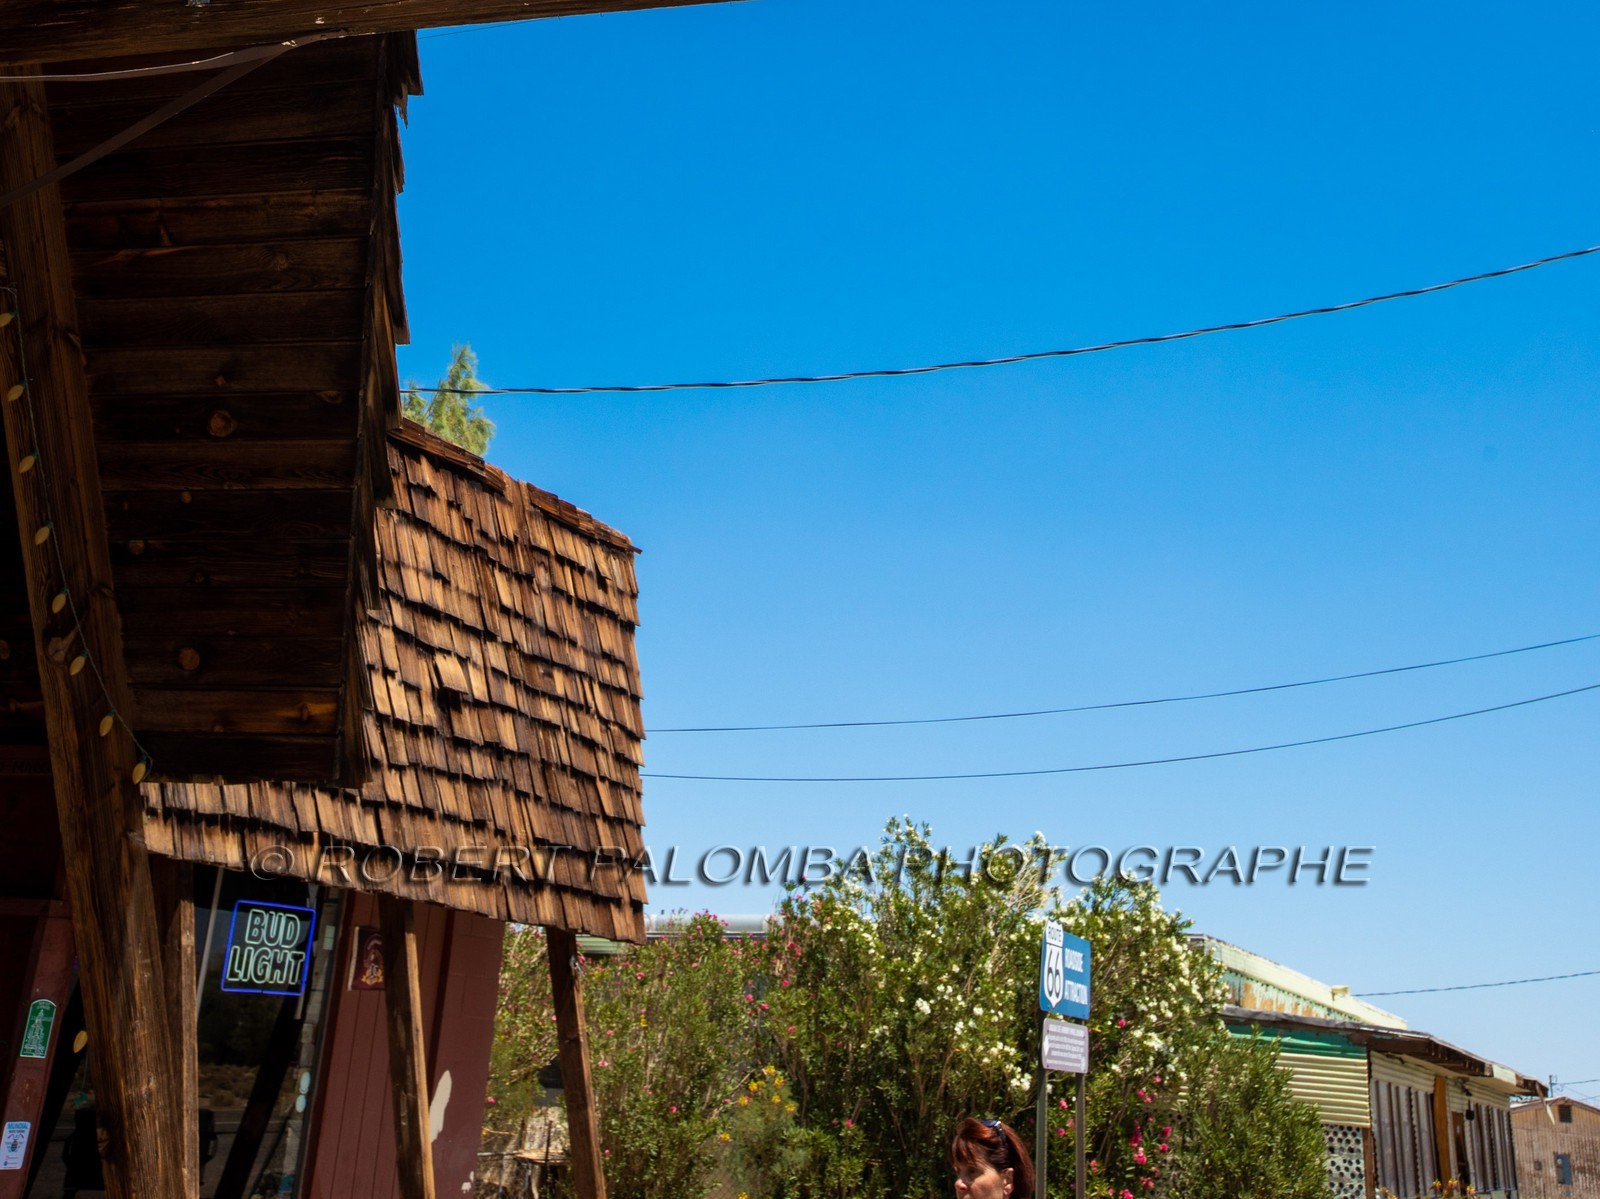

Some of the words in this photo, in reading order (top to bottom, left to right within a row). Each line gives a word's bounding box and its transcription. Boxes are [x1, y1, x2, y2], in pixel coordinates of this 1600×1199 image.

[246, 909, 300, 948] BUD
[227, 946, 305, 985] LIGHT
[1046, 947, 1061, 999] 66
